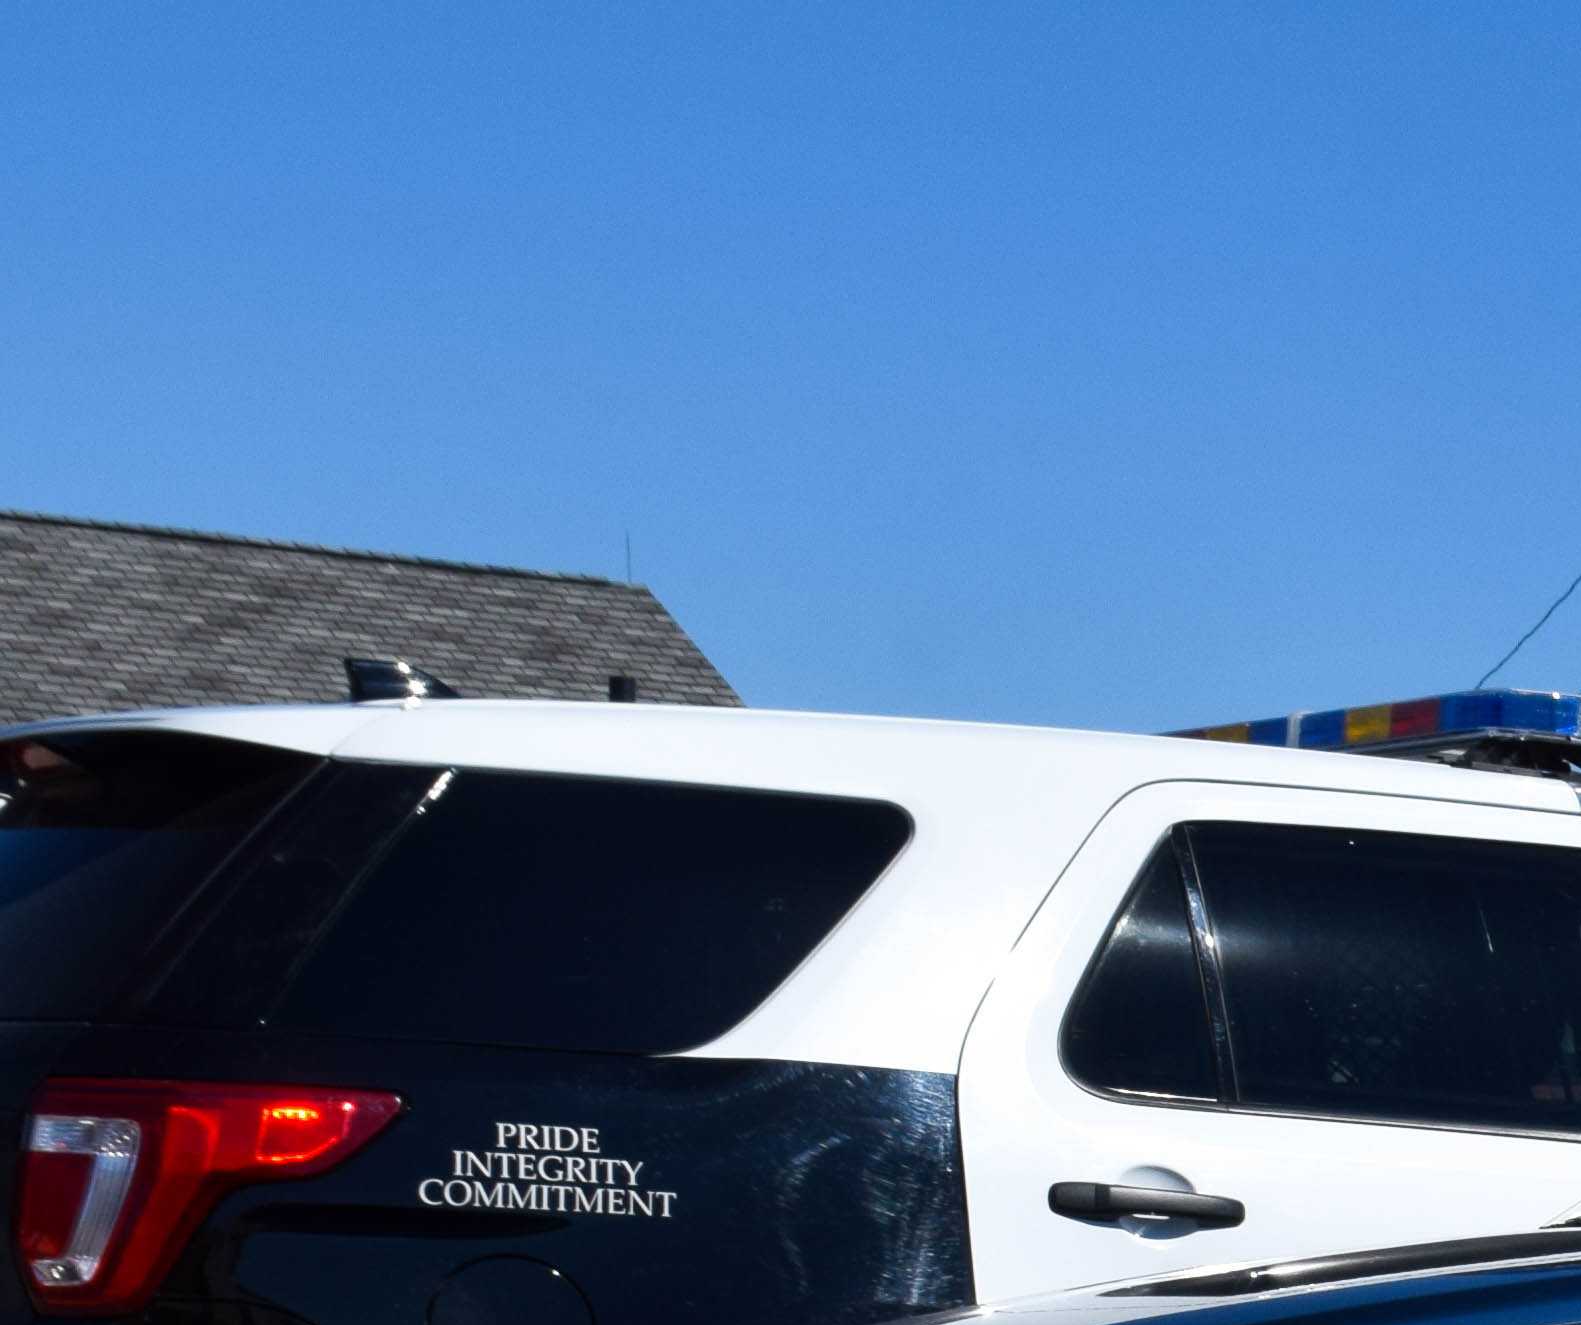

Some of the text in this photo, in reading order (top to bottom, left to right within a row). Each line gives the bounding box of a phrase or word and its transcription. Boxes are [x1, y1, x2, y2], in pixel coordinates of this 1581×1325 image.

[495, 1121, 601, 1154] PRIDE
[452, 1149, 645, 1186] INTEGRITY
[417, 1177, 679, 1218] COMMITMENT
